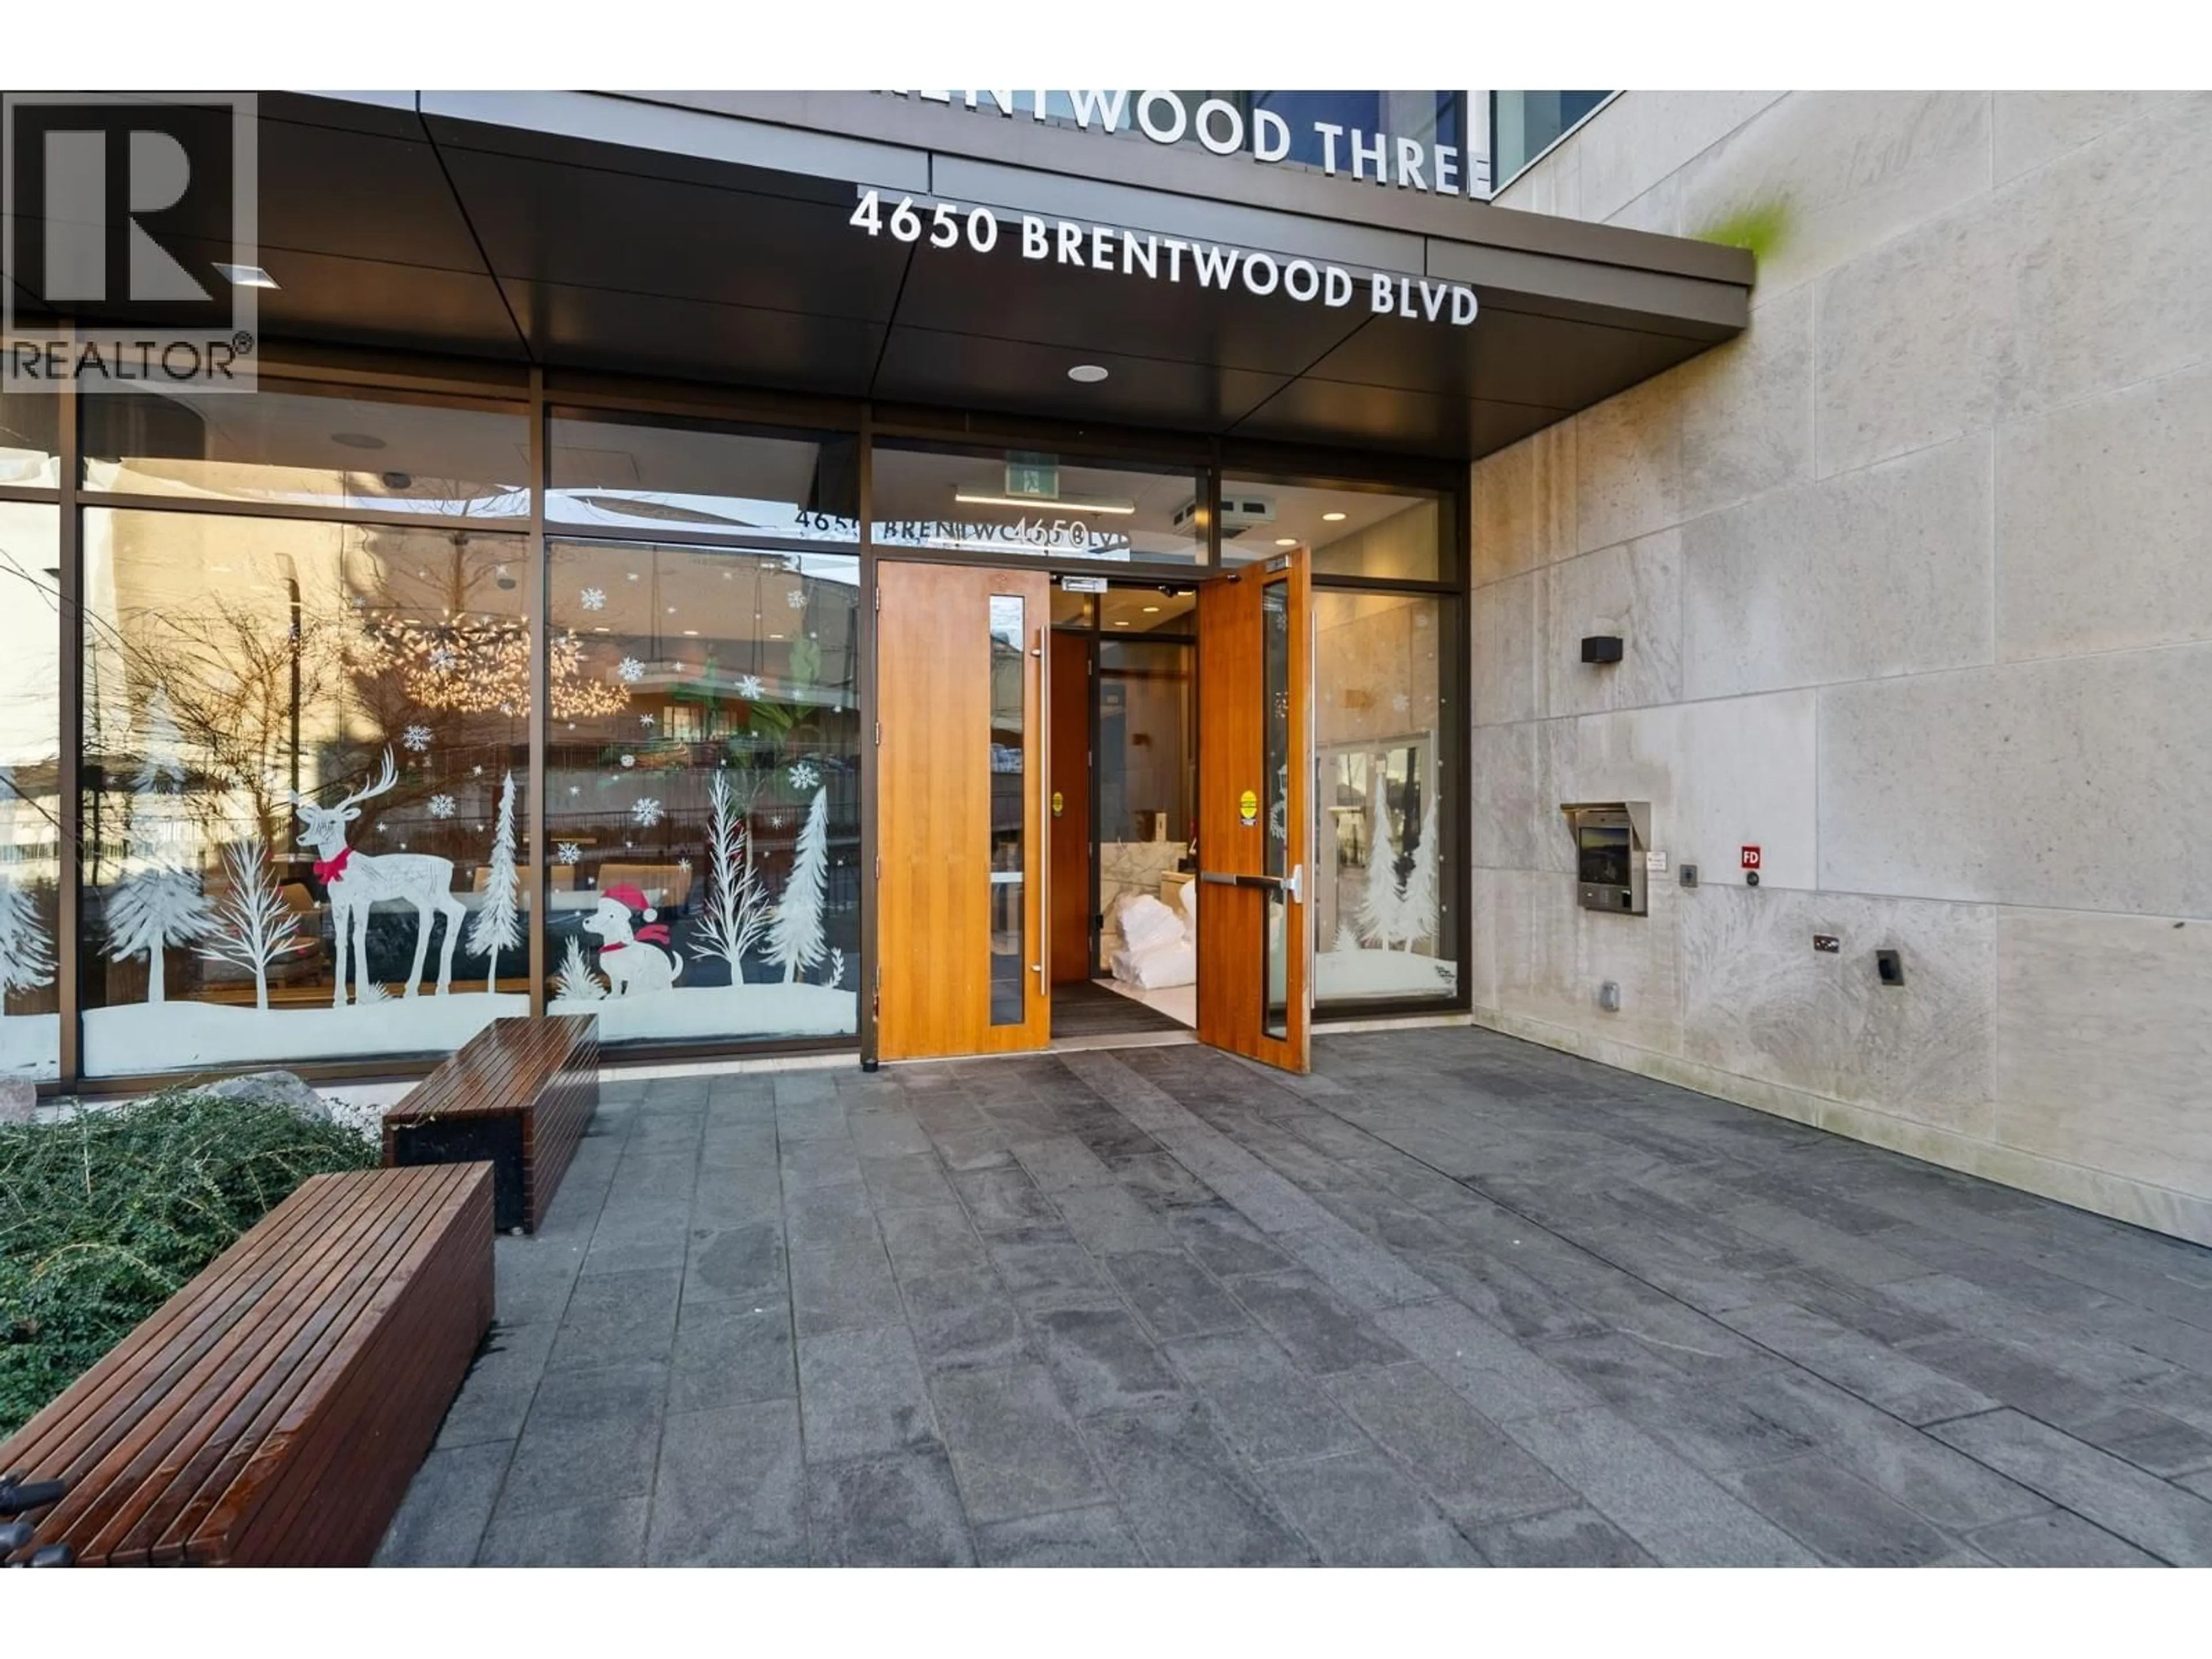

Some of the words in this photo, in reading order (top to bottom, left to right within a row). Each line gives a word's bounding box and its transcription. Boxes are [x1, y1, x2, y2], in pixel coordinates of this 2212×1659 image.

[1314, 122, 1491, 200] THREE
[850, 190, 997, 252] 4650
[1022, 215, 1352, 307] BRENTWOOD
[1372, 273, 1478, 325] BLVD
[1012, 517, 1087, 548] 4650
[1744, 851, 1758, 863] FD
